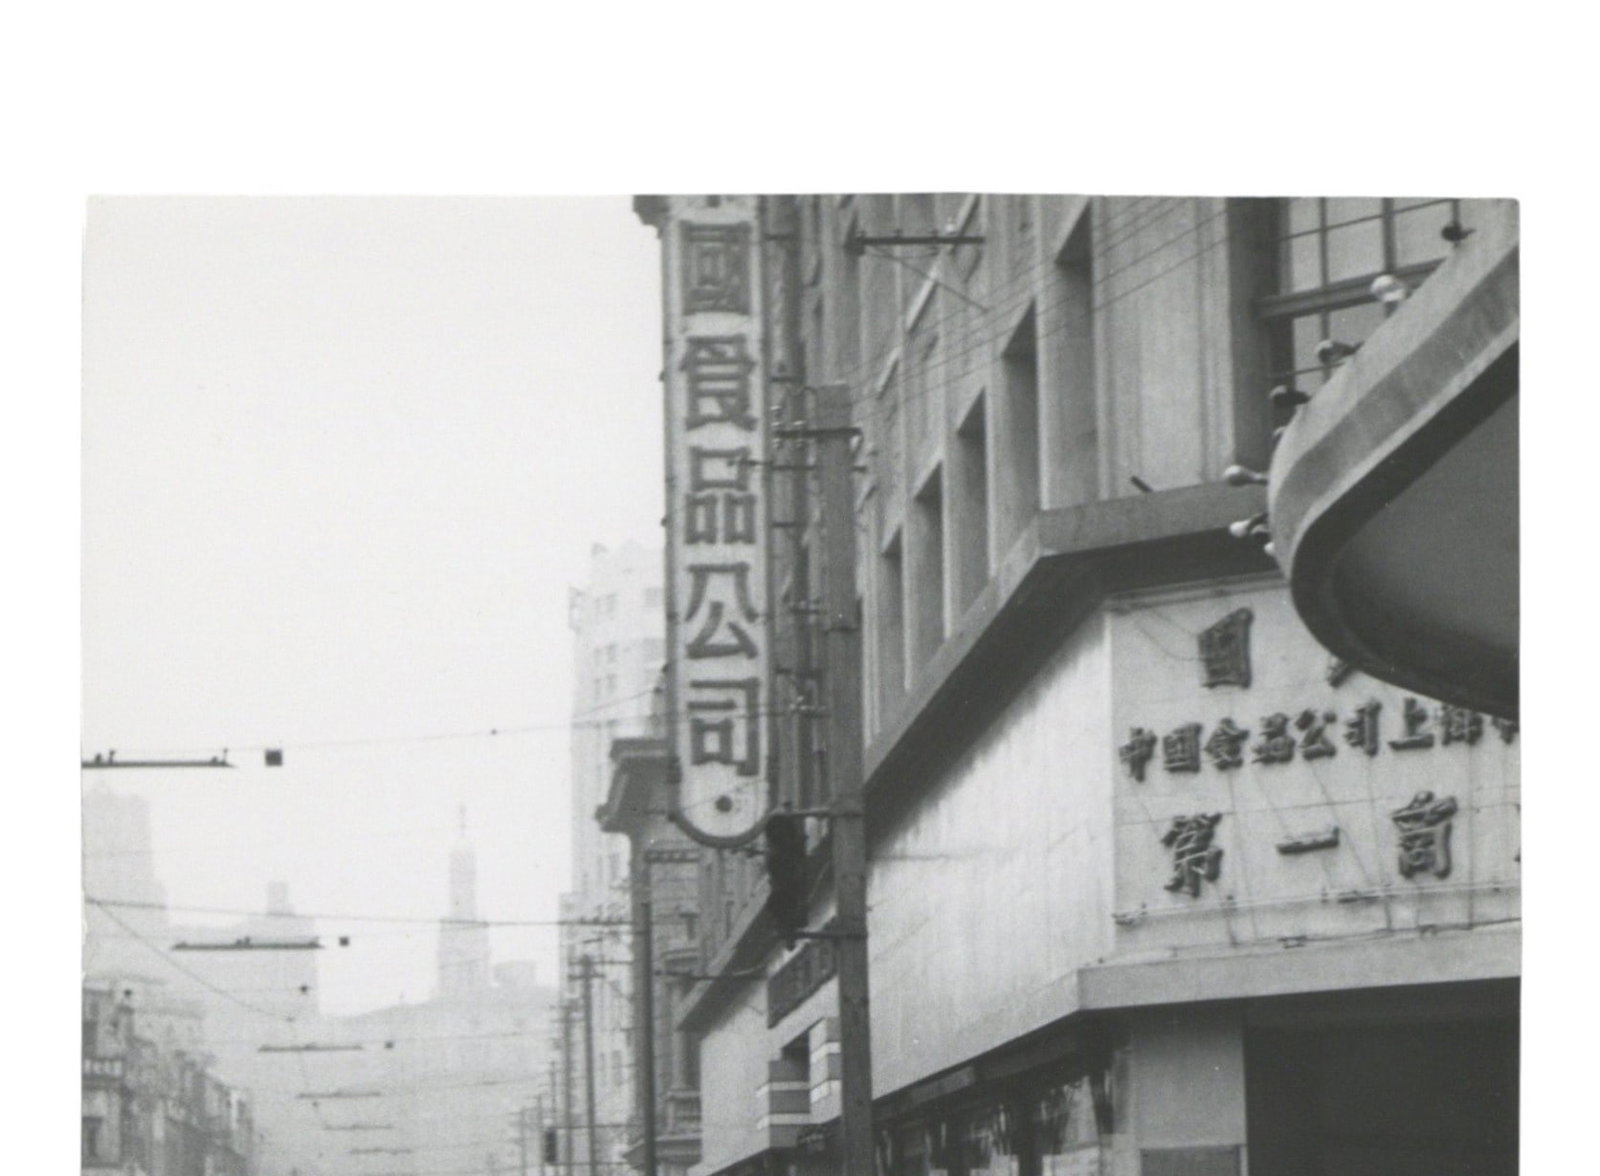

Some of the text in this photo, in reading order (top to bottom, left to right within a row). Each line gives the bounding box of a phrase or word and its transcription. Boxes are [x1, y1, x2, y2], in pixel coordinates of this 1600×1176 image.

[679, 194, 760, 777] 國食品公司
